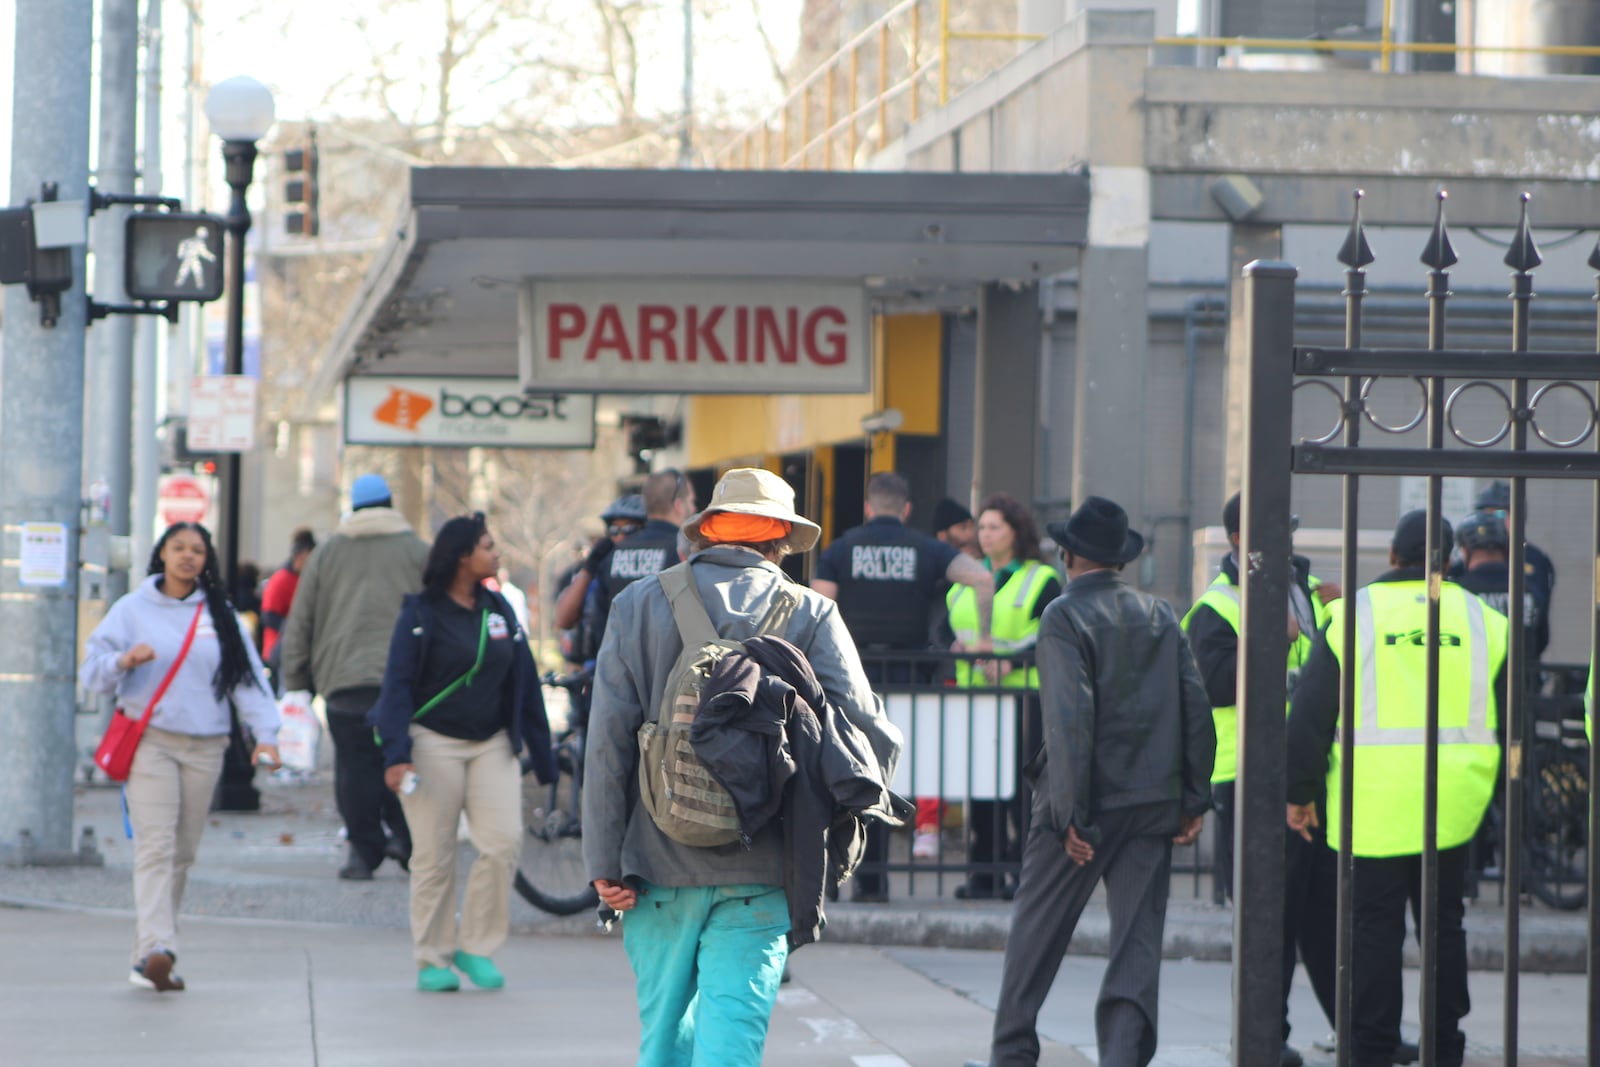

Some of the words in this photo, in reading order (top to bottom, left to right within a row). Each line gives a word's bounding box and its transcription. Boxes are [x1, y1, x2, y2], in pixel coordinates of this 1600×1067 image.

[547, 303, 848, 366] PARKING
[440, 386, 568, 420] boost
[613, 548, 667, 563] DAYTON
[852, 545, 917, 562] DAYTON
[610, 561, 661, 578] POLICE
[852, 561, 916, 580] POLICE
